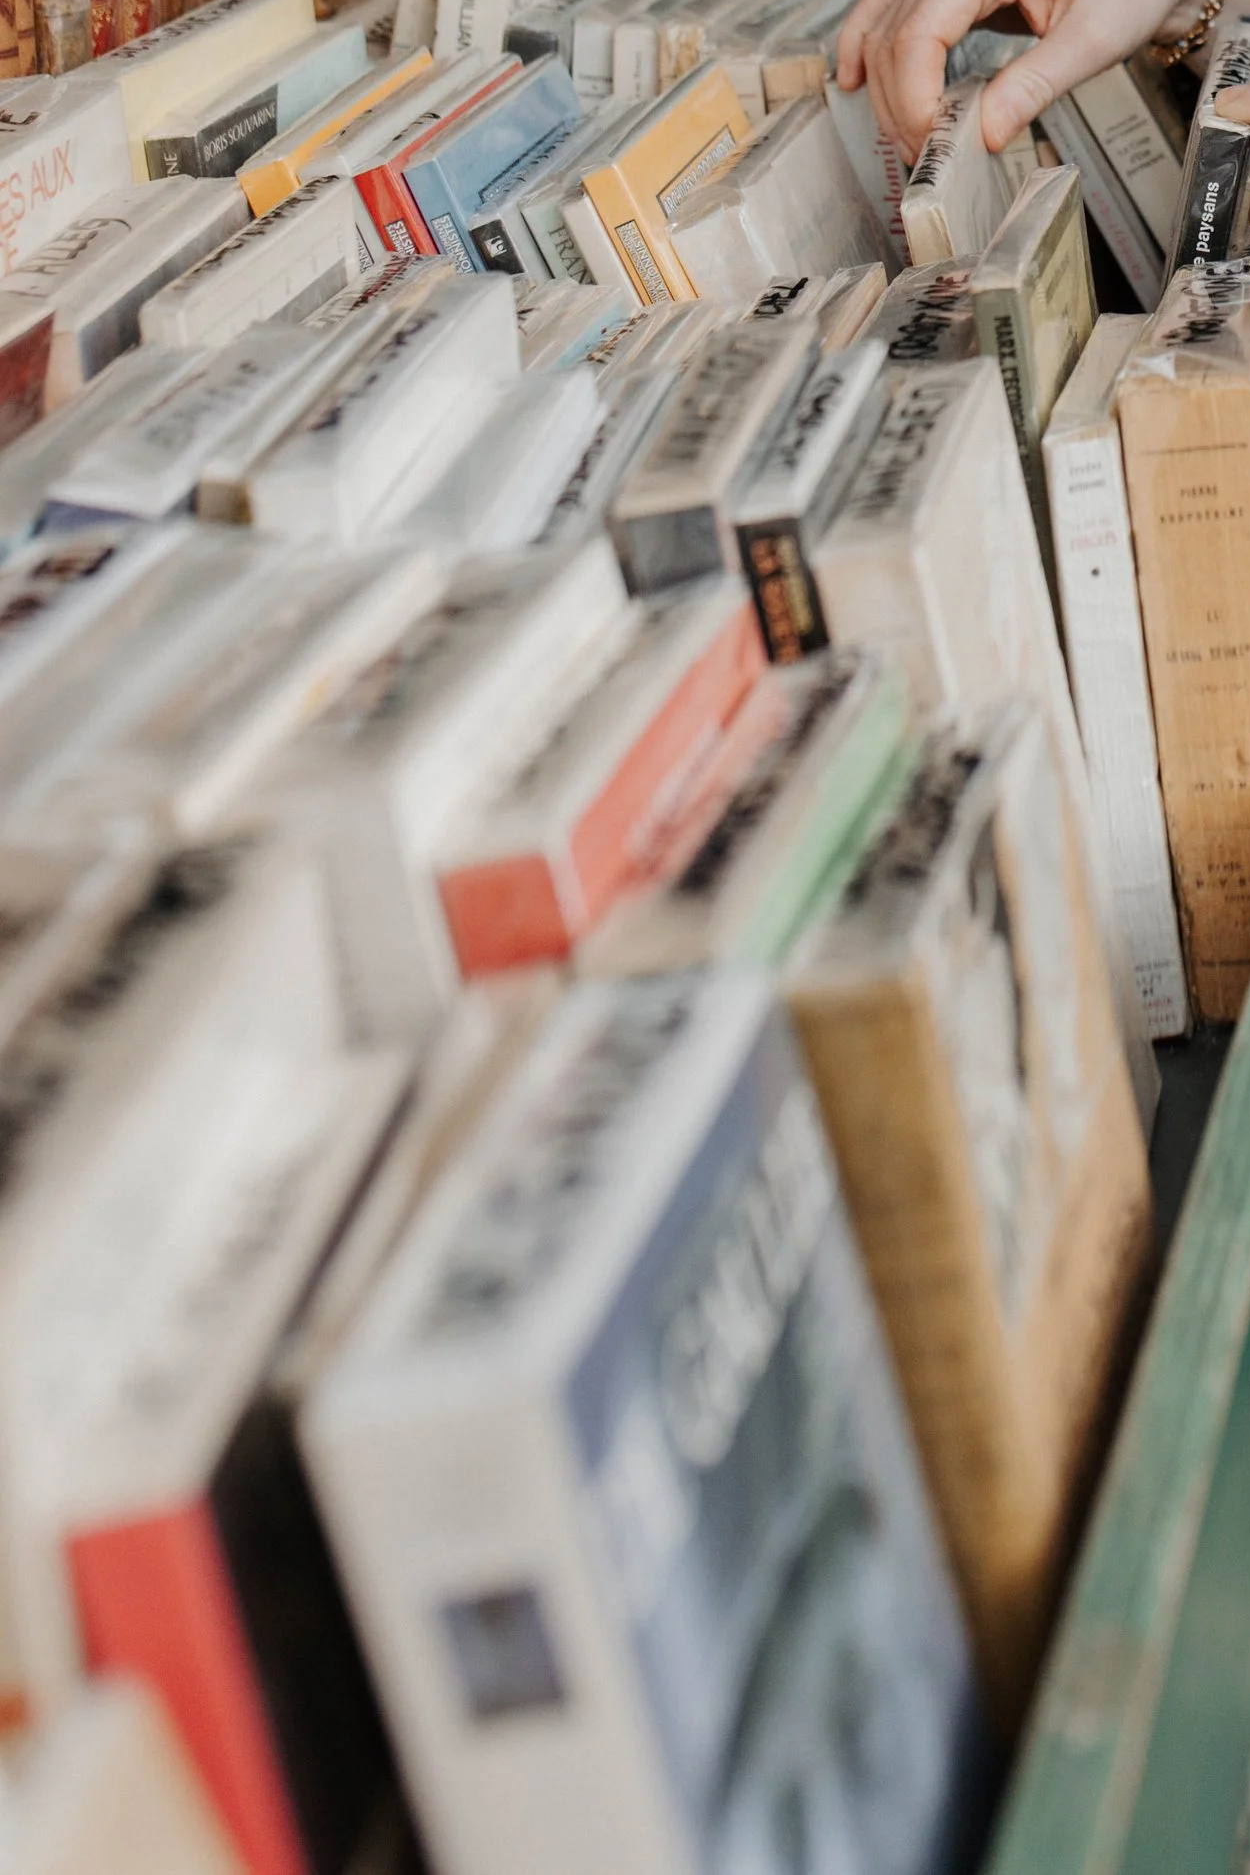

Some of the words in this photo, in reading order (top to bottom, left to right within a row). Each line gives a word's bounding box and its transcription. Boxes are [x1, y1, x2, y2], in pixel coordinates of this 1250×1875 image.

[203, 134, 228, 162] BORIS
[228, 102, 277, 146] SOUVARINE
[30, 138, 75, 210] AUX
[1196, 181, 1220, 252] paysans
